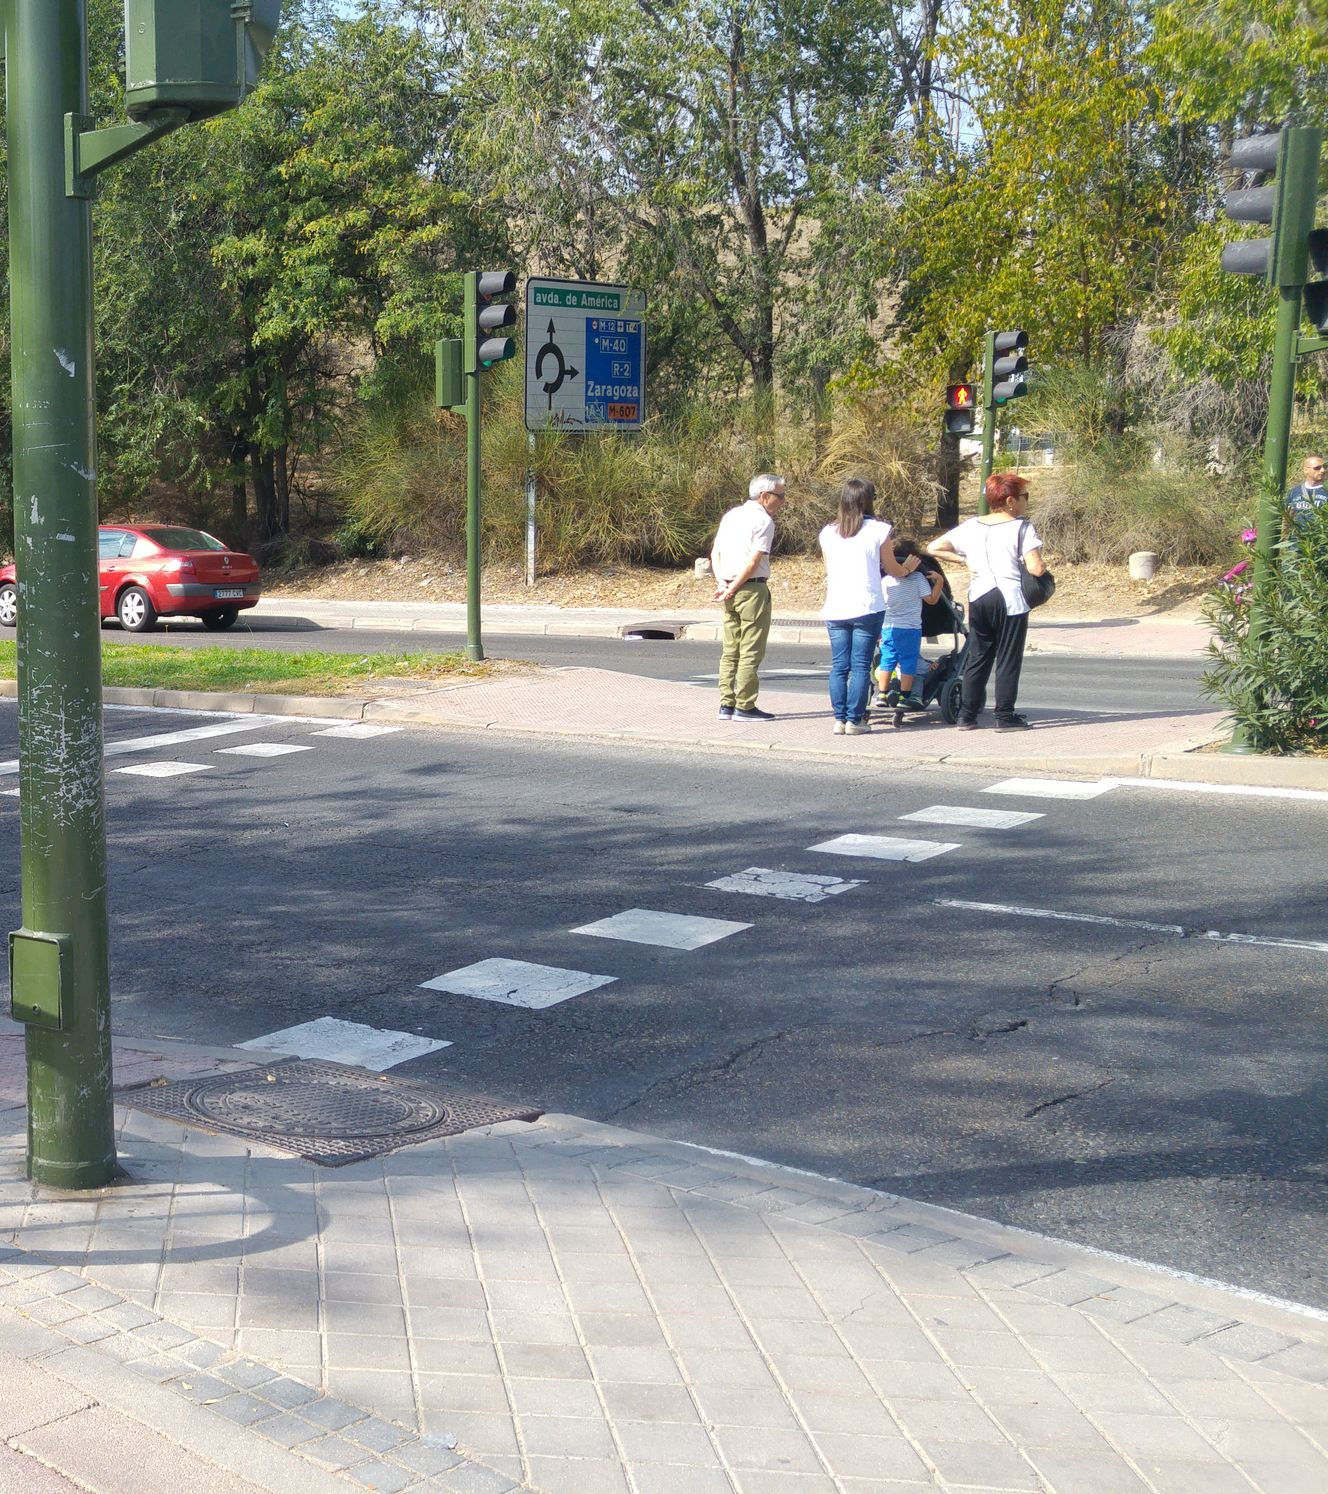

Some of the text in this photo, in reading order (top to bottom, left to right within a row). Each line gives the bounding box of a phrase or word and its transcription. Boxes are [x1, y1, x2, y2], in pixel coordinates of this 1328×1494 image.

[535, 292, 619, 309] avda. de América
[601, 338, 626, 352] M-40
[613, 363, 630, 377] R-2
[587, 380, 639, 400] Zaragoza
[609, 405, 636, 417] M-607
